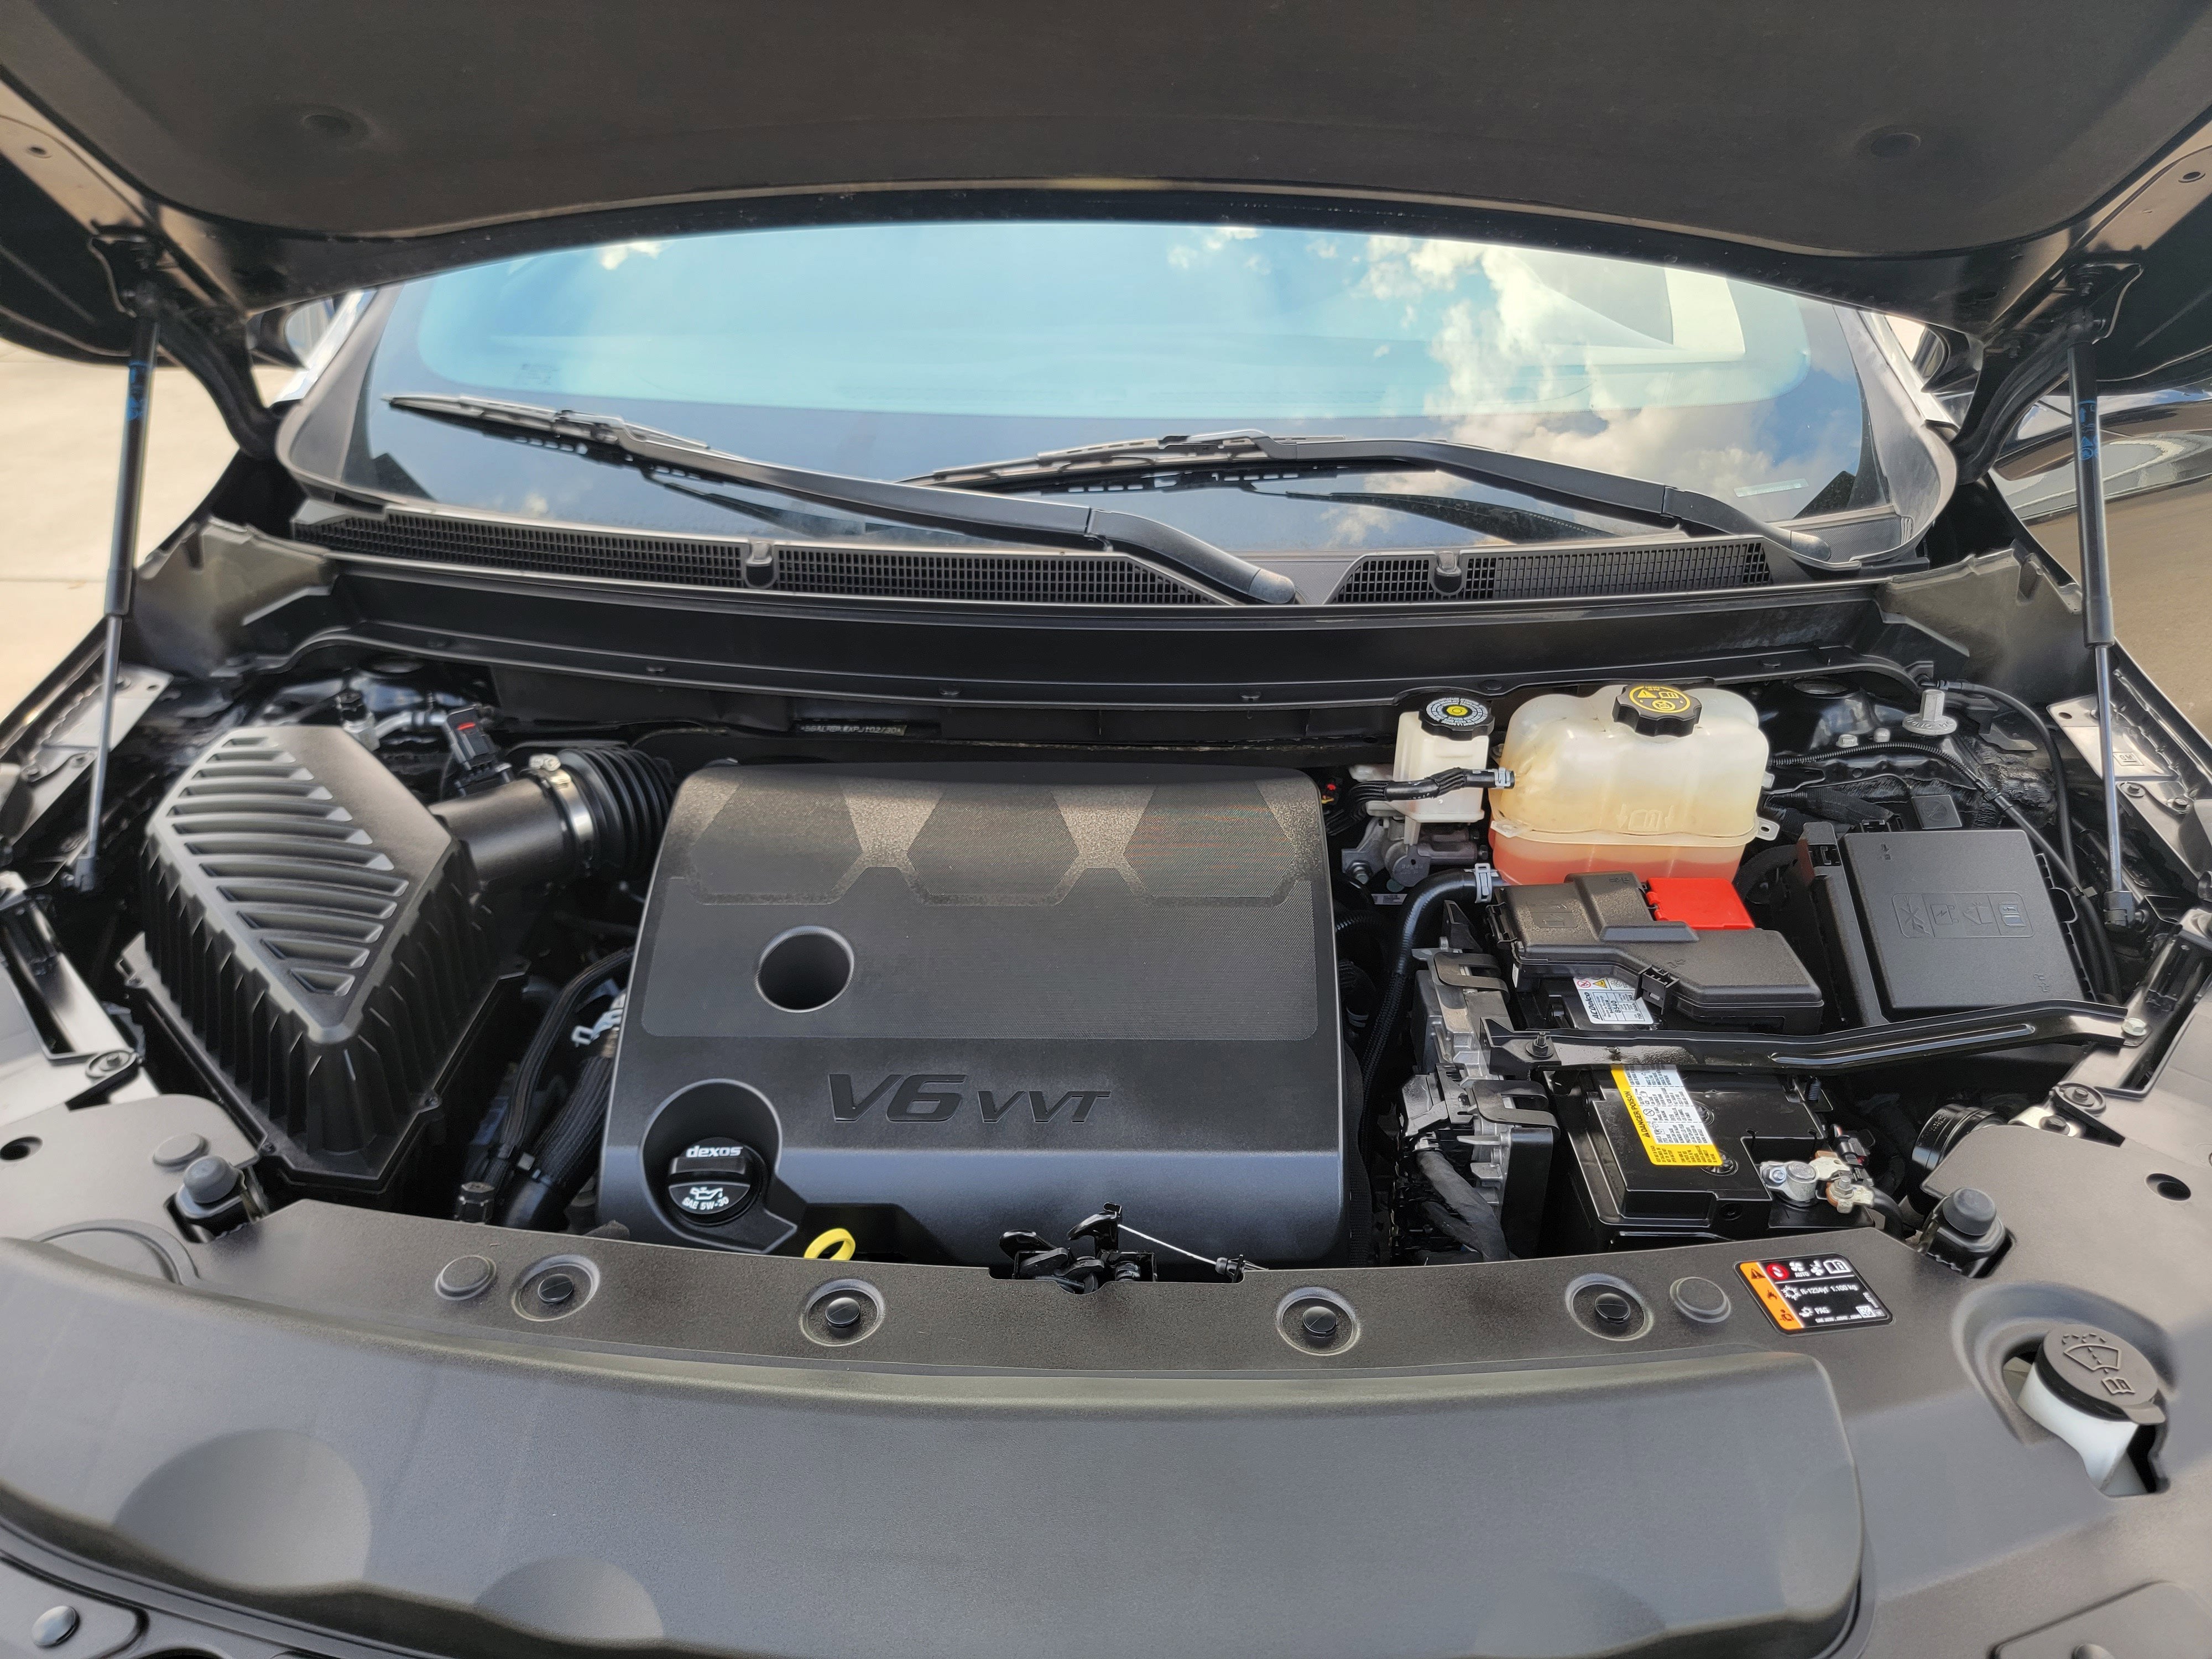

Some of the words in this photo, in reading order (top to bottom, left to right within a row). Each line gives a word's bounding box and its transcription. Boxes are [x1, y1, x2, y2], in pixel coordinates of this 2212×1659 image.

[1584, 992, 1600, 1020] ACDelco
[1611, 1000, 1621, 1014] 8540
[827, 1074, 968, 1123] V6
[977, 1090, 1112, 1123] VVT
[1624, 1091, 1648, 1134] DANGER/POISON
[686, 1145, 743, 1158] dexos
[681, 1197, 700, 1210] SAE
[700, 1196, 729, 1210] 5W-30
[1800, 1286, 1829, 1295] R-1234yf
